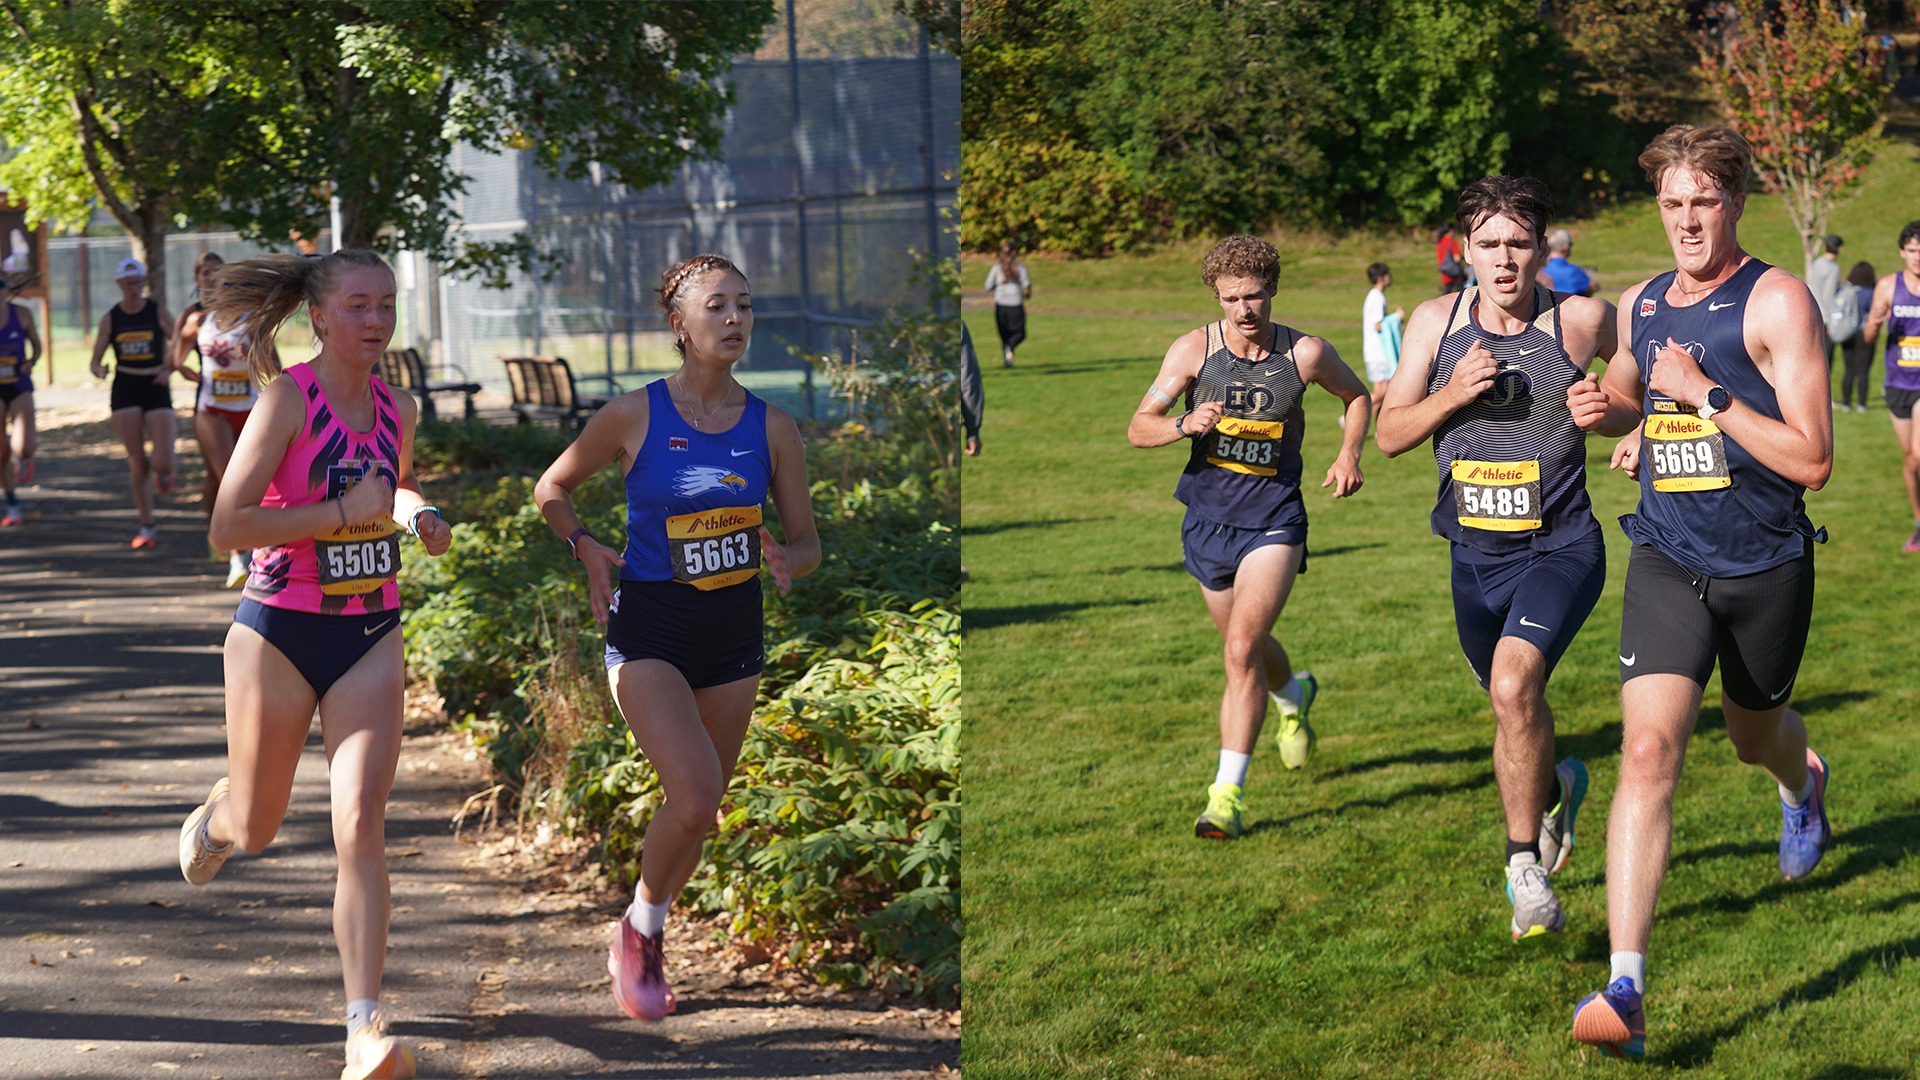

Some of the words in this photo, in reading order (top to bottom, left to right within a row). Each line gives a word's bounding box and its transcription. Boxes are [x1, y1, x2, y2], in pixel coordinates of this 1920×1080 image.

[1217, 436, 1272, 465] 5483
[1652, 441, 1714, 474] 5669
[1464, 486, 1530, 516] 5489
[327, 540, 392, 578] 5503
[683, 533, 750, 575] 5663
